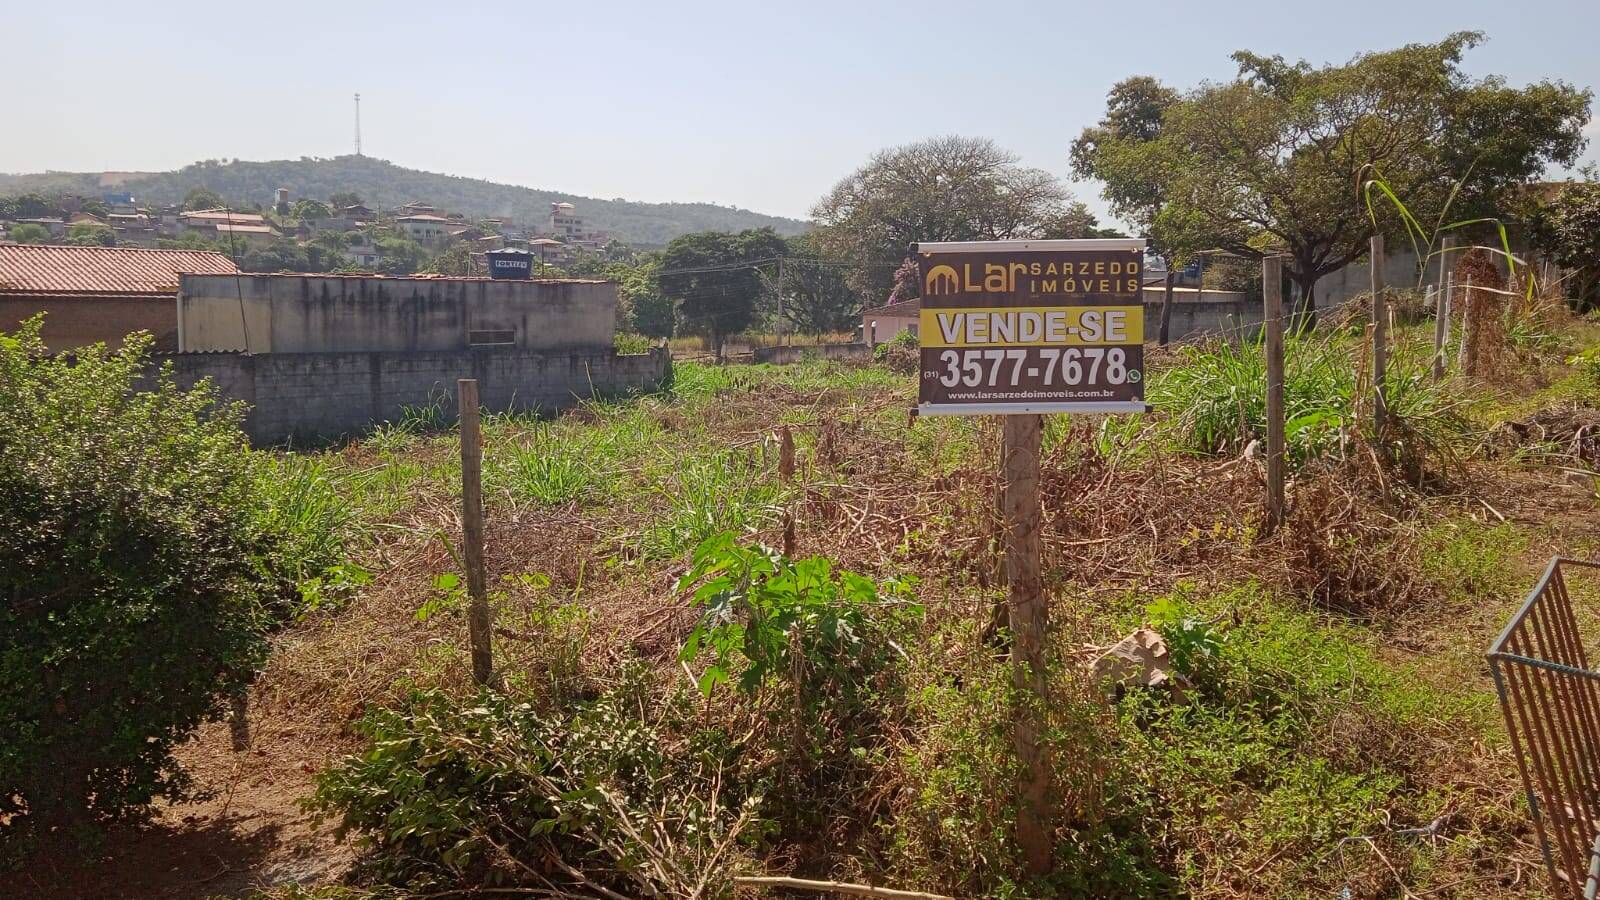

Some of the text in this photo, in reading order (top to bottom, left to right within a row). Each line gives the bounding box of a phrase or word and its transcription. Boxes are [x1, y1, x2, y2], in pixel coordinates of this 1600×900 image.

[964, 263, 1027, 293] Lar
[1031, 262, 1139, 275] SARZEDO
[1031, 278, 1138, 293] IMÓVEIS
[937, 310, 1127, 344] VENDE-SE
[924, 348, 1127, 387] (31) 3577-7678
[947, 390, 1115, 399] www.larsarzedoimoveis.com.br
